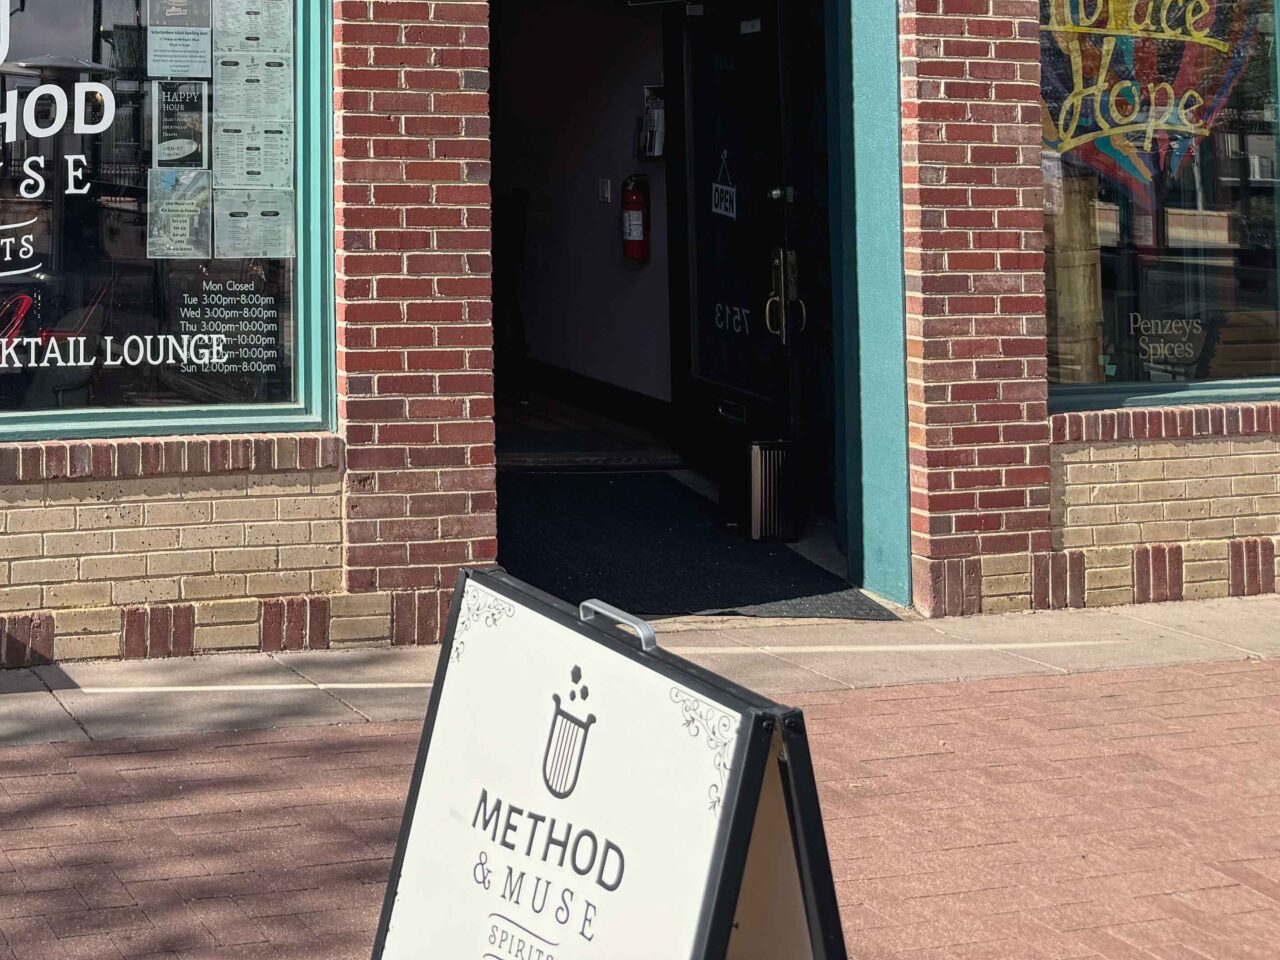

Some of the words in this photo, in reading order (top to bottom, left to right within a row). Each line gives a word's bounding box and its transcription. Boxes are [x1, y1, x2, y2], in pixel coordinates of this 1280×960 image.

[162, 91, 199, 102] HAPPY
[1058, 36, 1204, 151] Hope
[163, 103, 185, 111] HOUR
[714, 186, 734, 216] OPEN
[202, 281, 223, 291] Mon
[226, 280, 255, 291] Closed
[183, 294, 198, 305] Tue
[202, 293, 275, 306] 3:00pm-8:00pm
[180, 307, 201, 318] Wed
[204, 307, 277, 320] 3:00pm-8:00pm
[180, 321, 197, 332] Thu
[201, 321, 277, 334] 3:00pm-10:00pm
[1130, 312, 1202, 337] Penzeys
[104, 334, 229, 366] LOUNGE
[1138, 338, 1194, 363] Spices
[180, 362, 197, 373] Sun
[201, 361, 277, 375] 12:00pm-8:00pm
[471, 787, 625, 892] METHOD
[473, 851, 492, 890] &
[500, 865, 597, 942] MUSE
